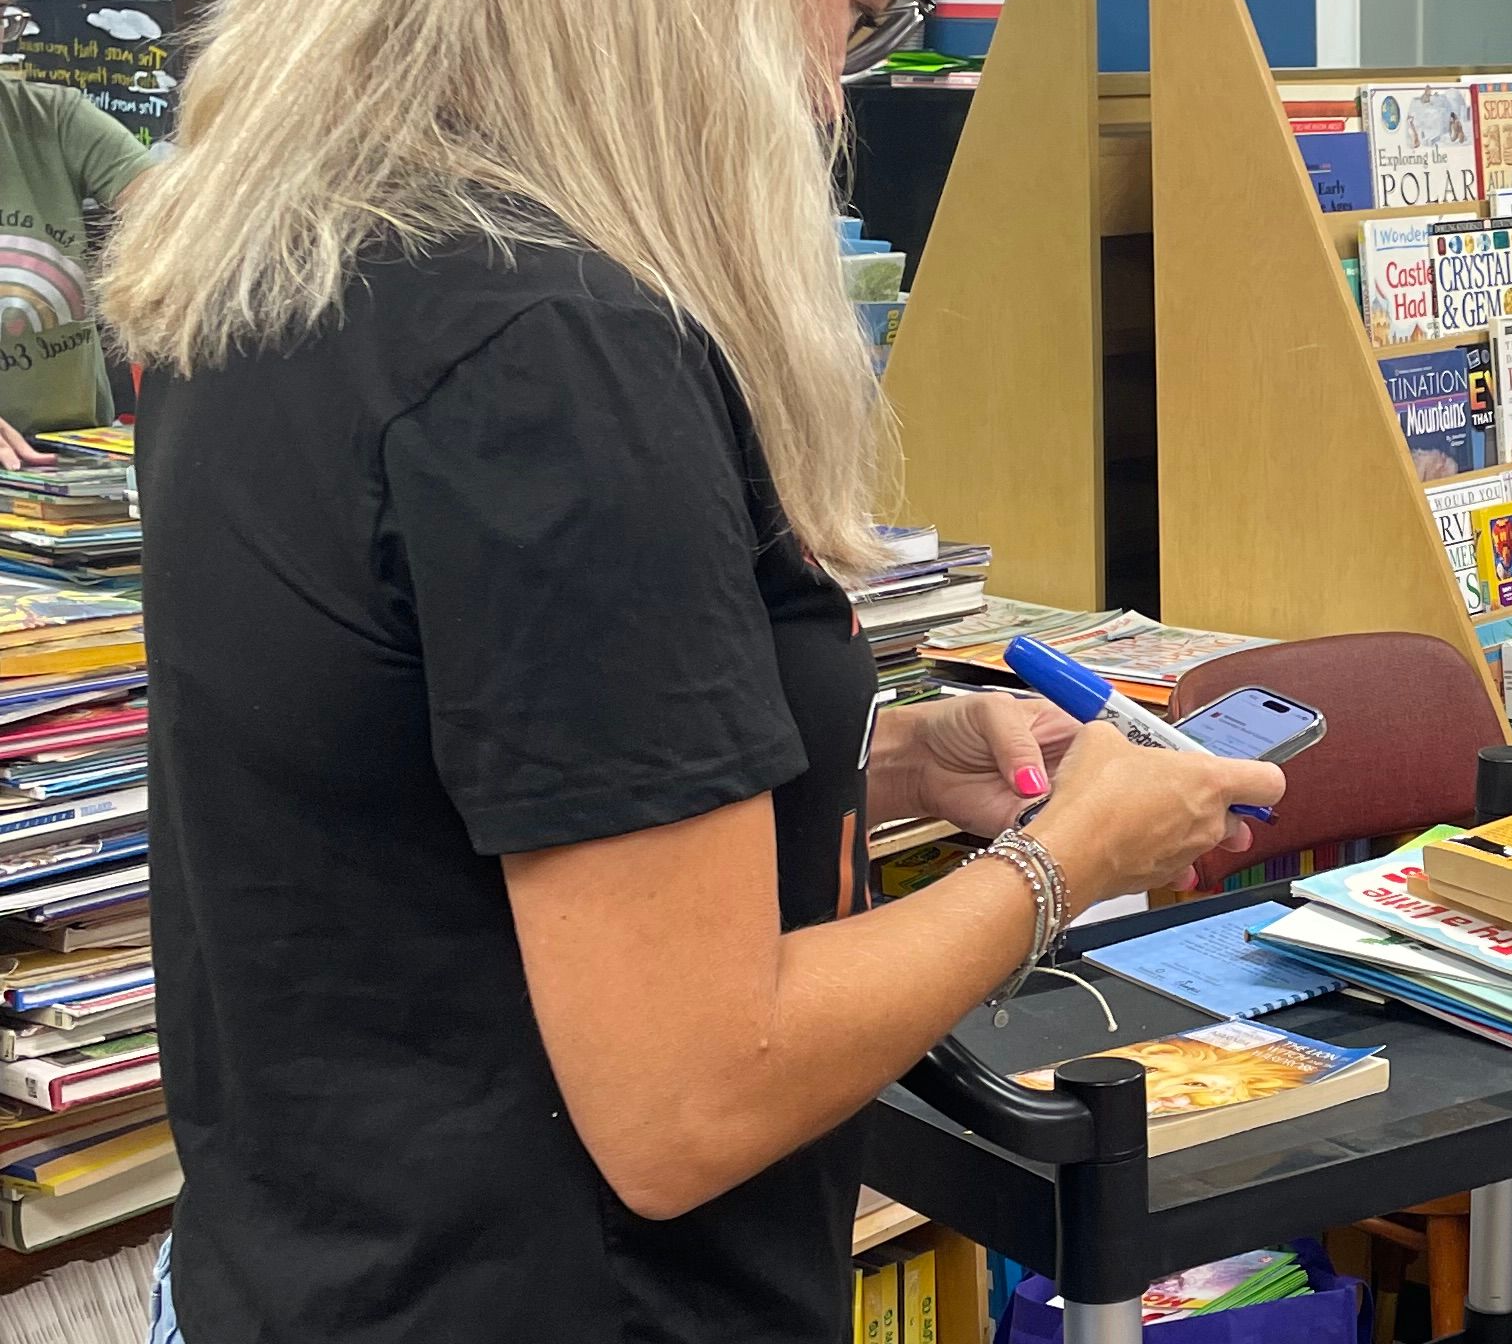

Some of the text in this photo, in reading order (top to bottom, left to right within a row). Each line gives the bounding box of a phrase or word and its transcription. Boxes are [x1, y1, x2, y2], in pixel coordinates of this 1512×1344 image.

[1379, 144, 1447, 171] Exploring the
[1381, 169, 1476, 206] POLAR
[1394, 294, 1427, 320] Had
[1384, 368, 1467, 402] TINATION
[1407, 399, 1466, 437] Mountains
[1472, 411, 1493, 425] THAT
[1435, 491, 1474, 509] WOULD
[1362, 887, 1450, 919] Little
[1440, 915, 1473, 927] a
